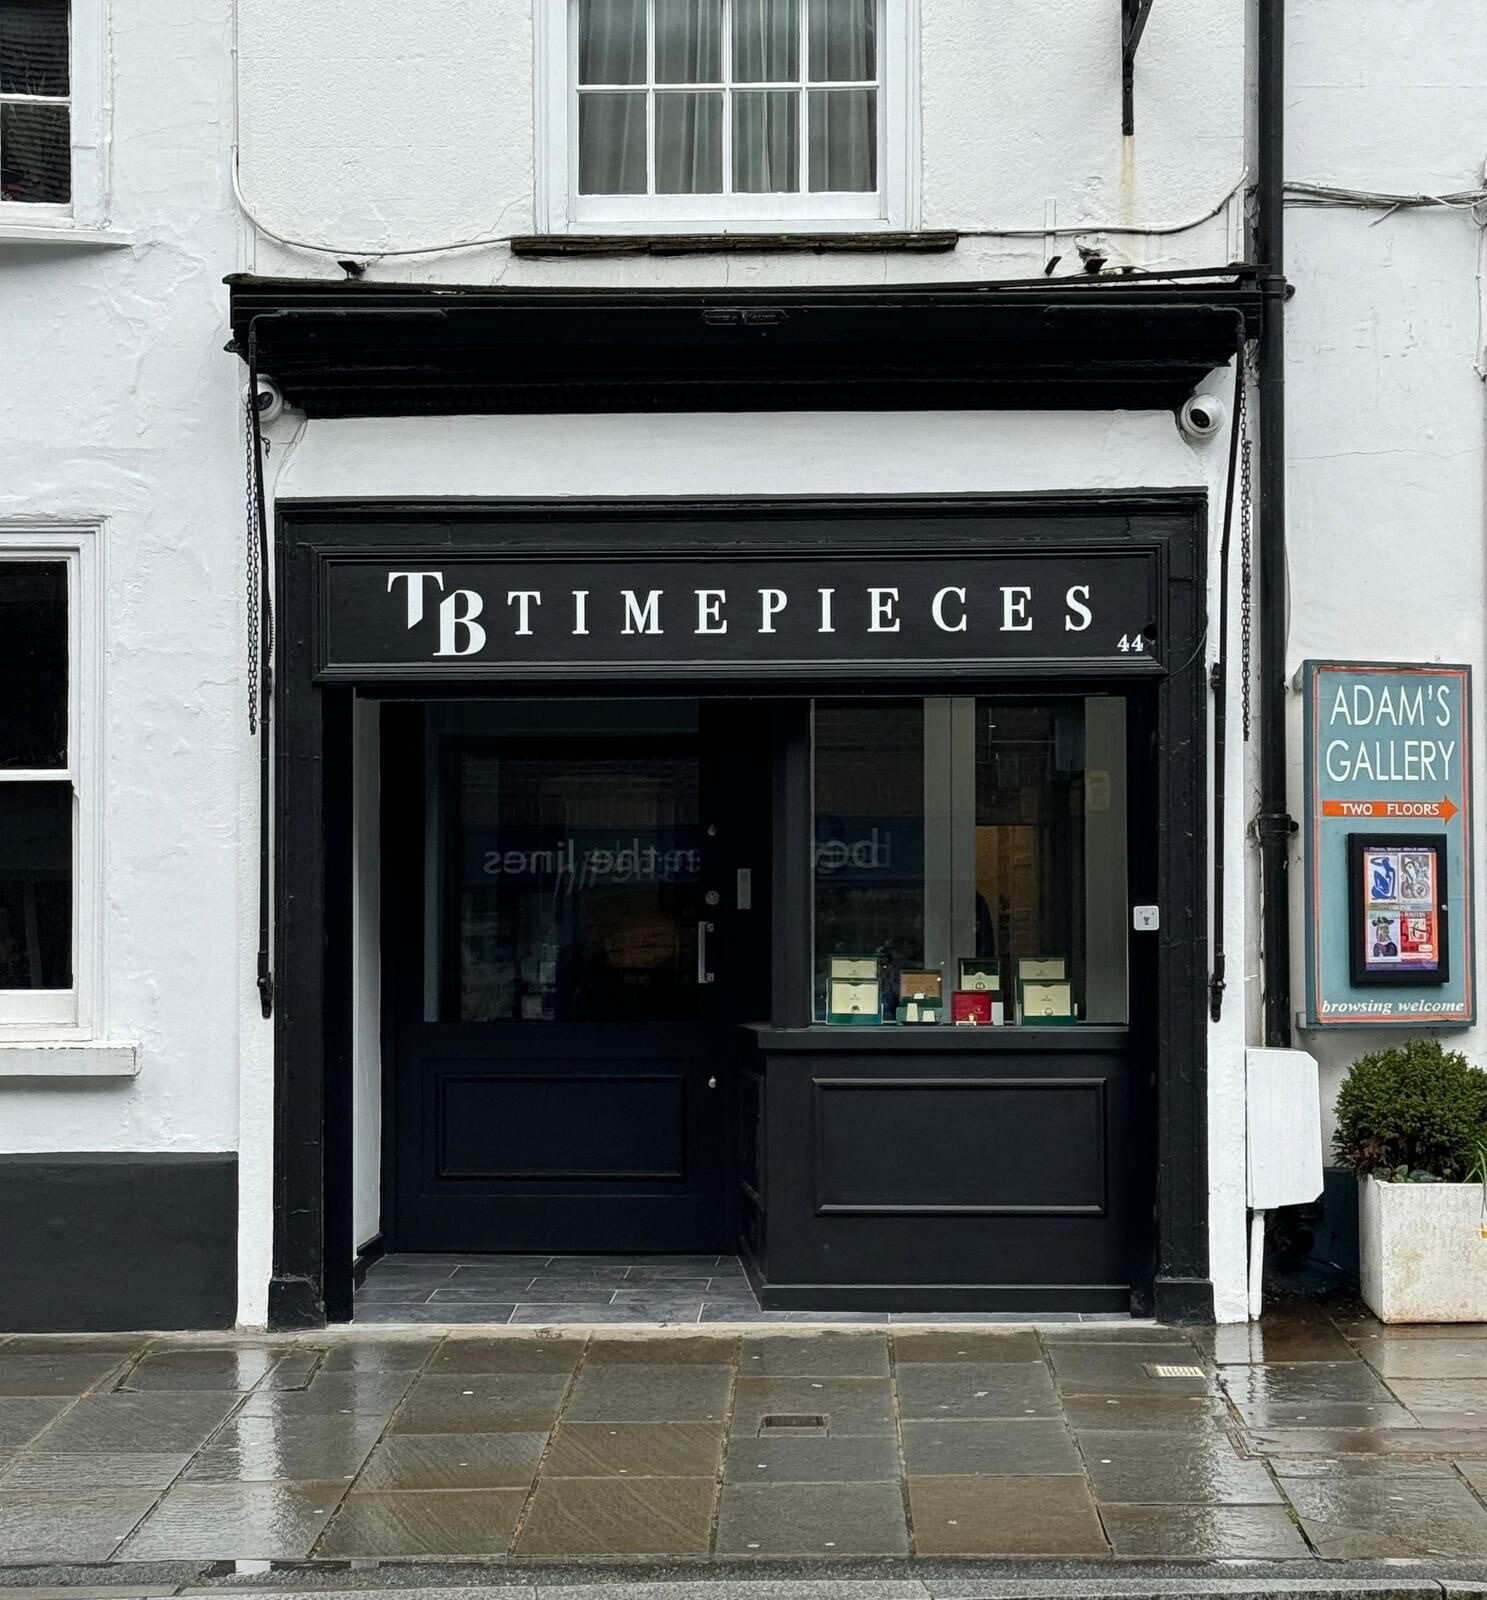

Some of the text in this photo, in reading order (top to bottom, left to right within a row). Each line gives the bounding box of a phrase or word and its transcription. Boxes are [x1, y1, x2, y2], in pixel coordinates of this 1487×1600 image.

[388, 571, 1092, 656] TB TIMEPIECES
[1117, 633, 1144, 652] 44
[1330, 684, 1451, 727] ADAM'S
[1325, 739, 1456, 782] GALLERY
[1340, 802, 1440, 816] TWO FLOORS
[1321, 999, 1464, 1016] browsing welcome
